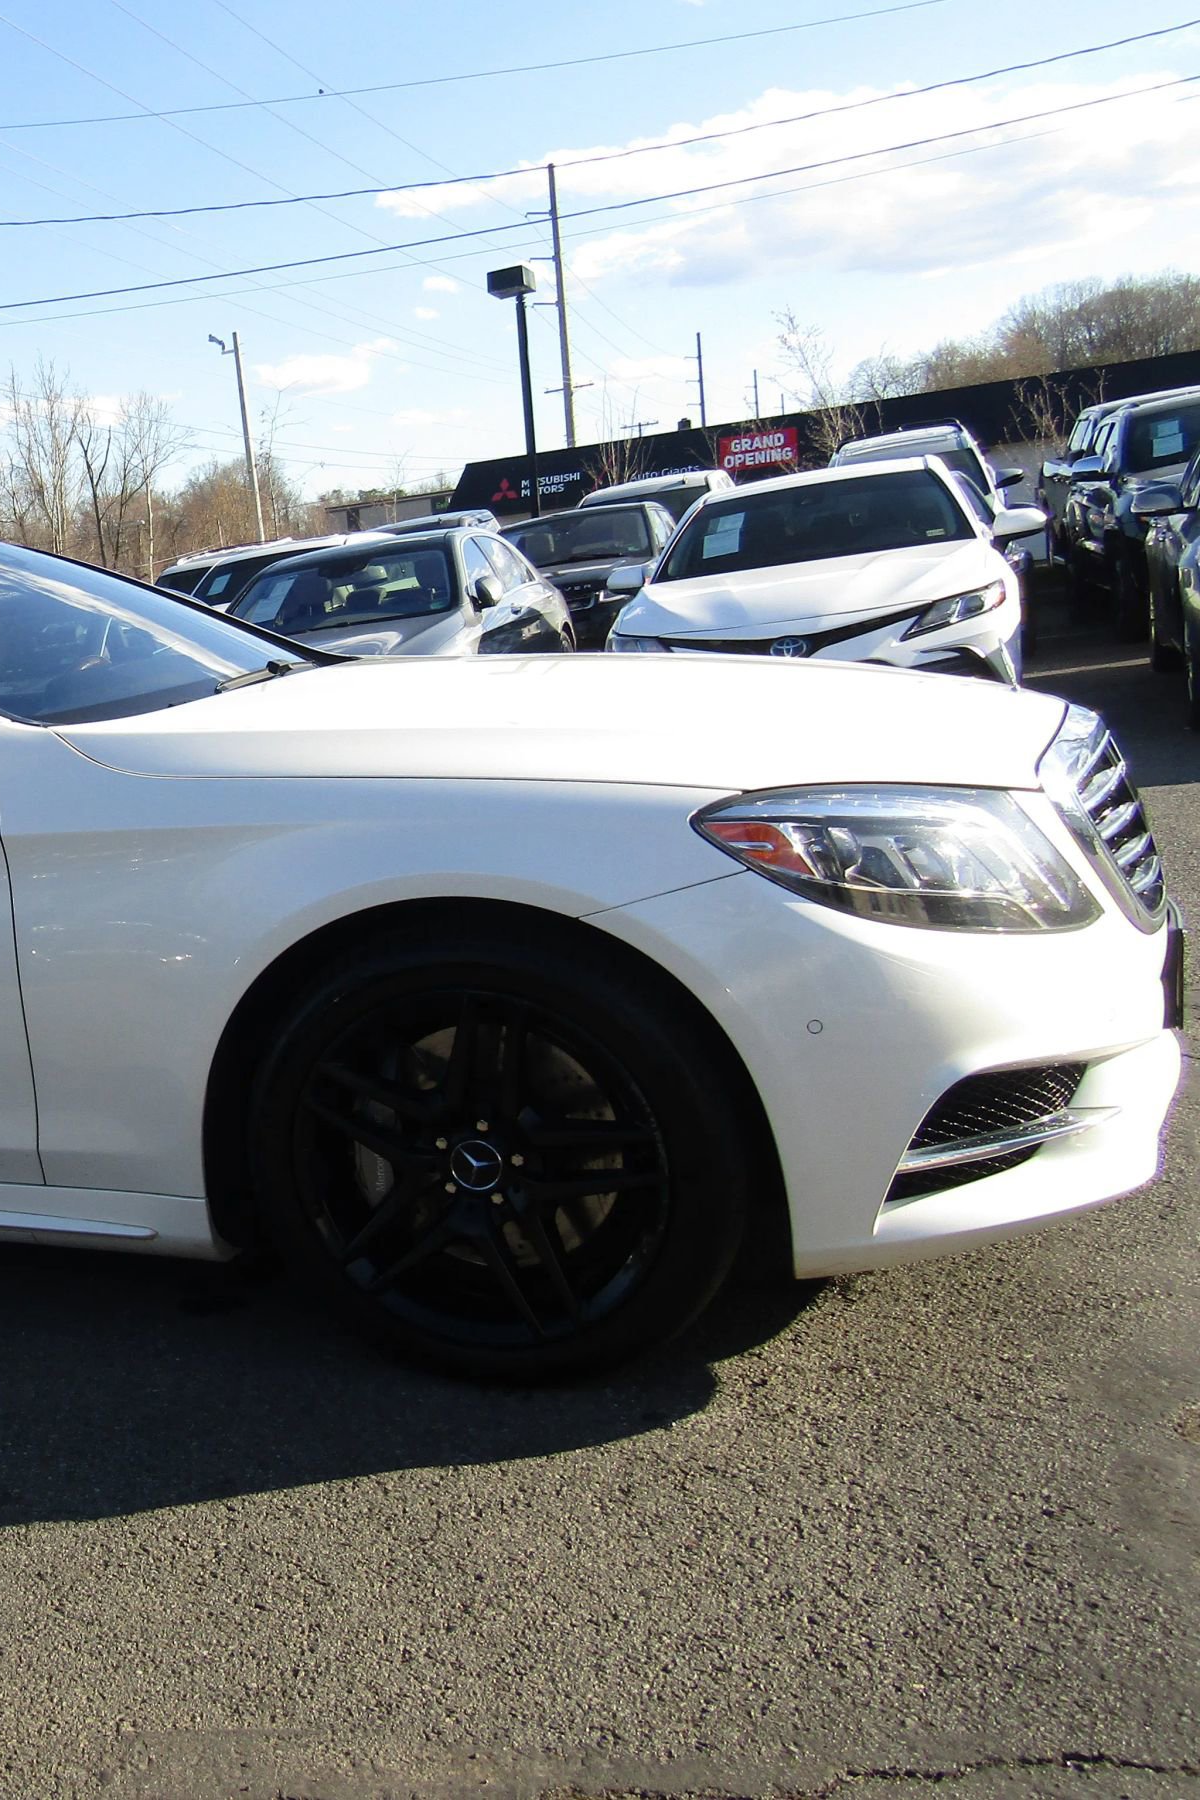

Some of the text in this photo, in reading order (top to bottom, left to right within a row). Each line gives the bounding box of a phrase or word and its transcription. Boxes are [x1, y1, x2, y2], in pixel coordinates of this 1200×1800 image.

[731, 433, 784, 452] GRAND
[724, 447, 793, 468] OPENING
[521, 472, 580, 488] MSUBISHI
[630, 465, 700, 481] Auto Giants
[521, 484, 564, 498] MTORS
[564, 584, 591, 592] VER
